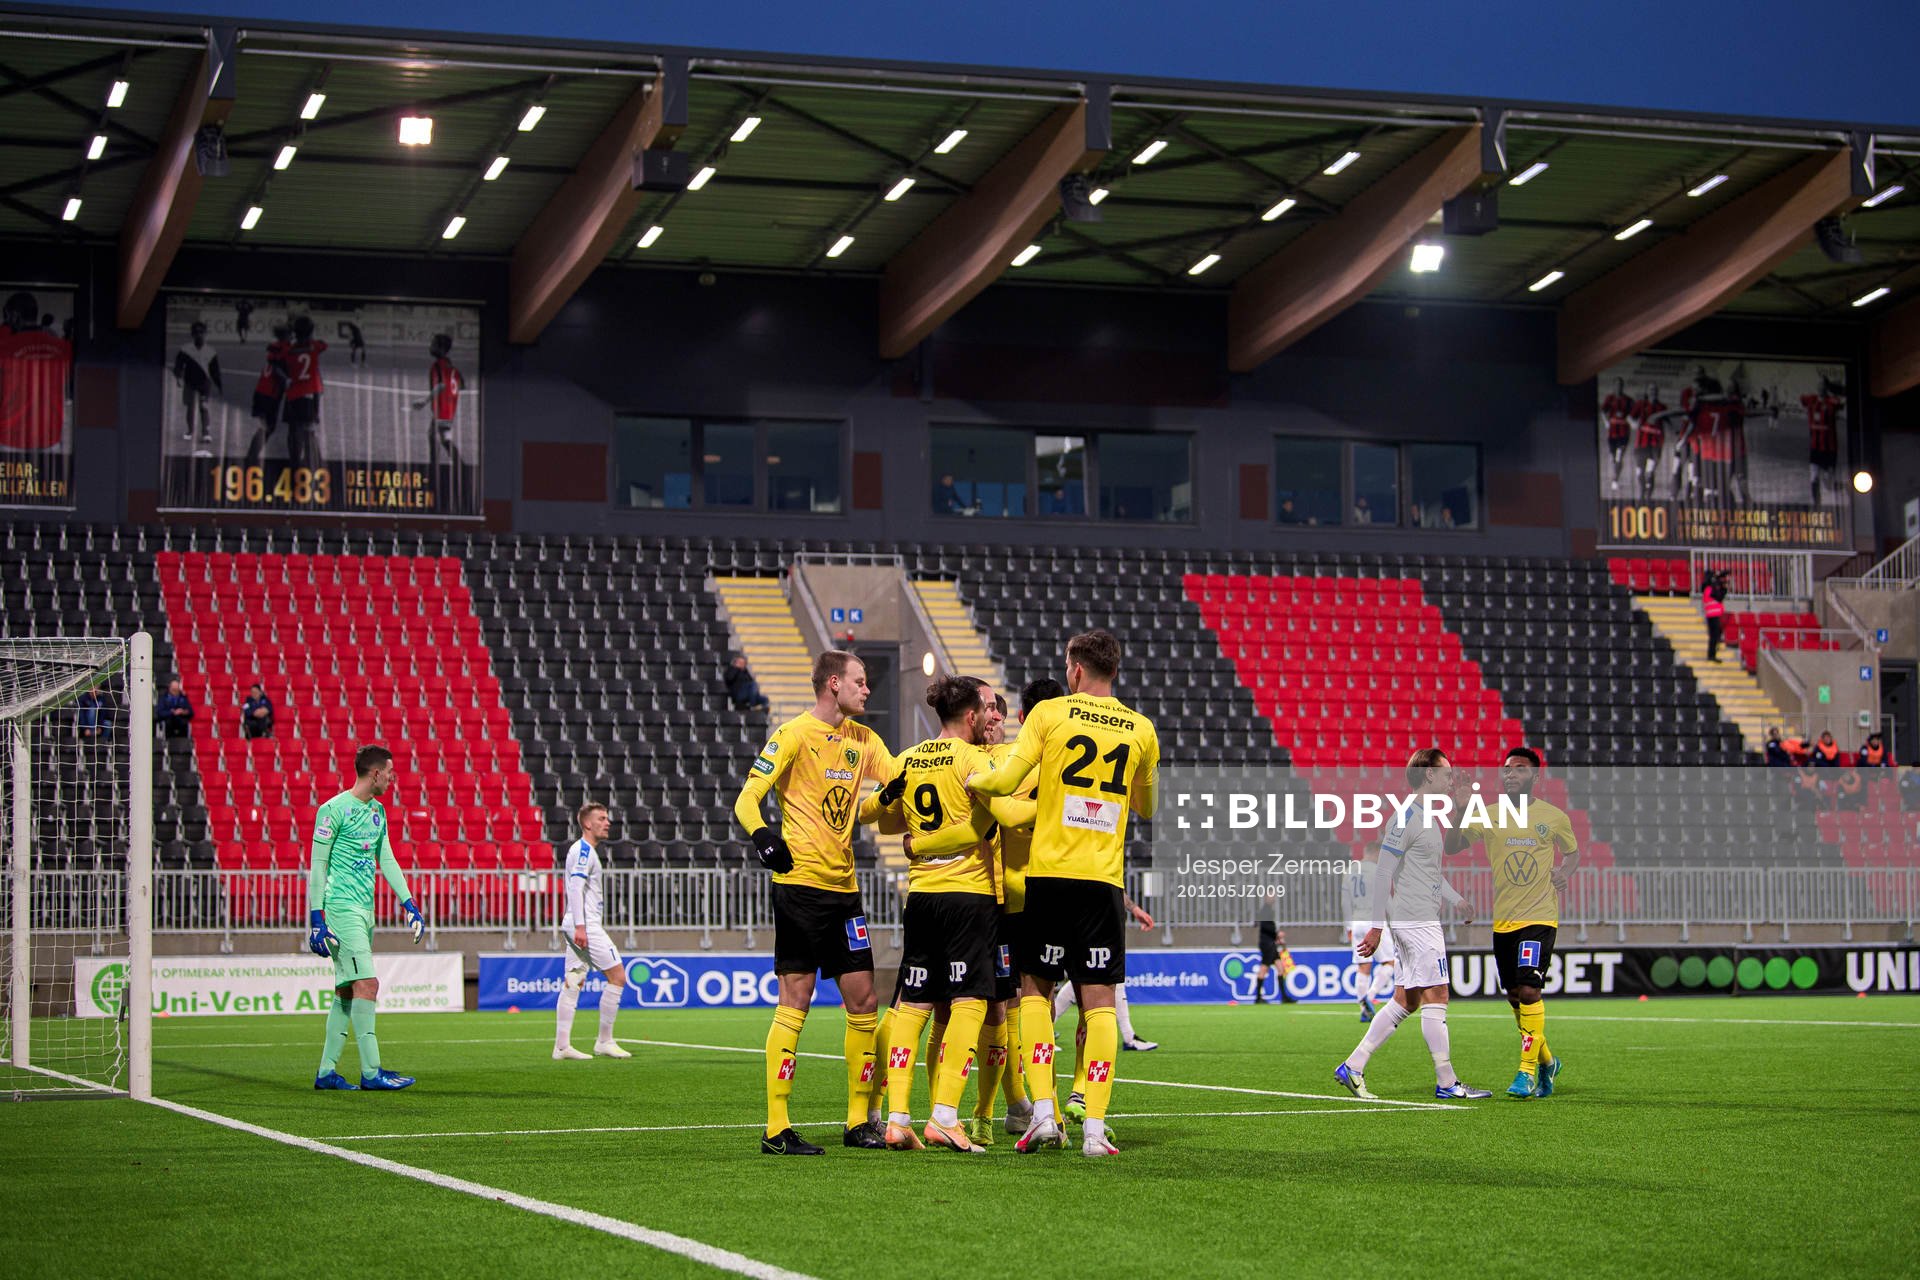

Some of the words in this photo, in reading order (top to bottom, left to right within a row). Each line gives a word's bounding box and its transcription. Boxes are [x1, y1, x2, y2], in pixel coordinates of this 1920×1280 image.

[298, 352, 311, 380] 2
[211, 464, 331, 504] 196.483
[347, 469, 429, 488] DELTAGAR-
[347, 486, 434, 508] TILLFÄLLEN
[1609, 506, 1668, 540] 1000
[1069, 707, 1135, 732] Passera
[904, 755, 953, 770] Passera
[1061, 734, 1130, 796] 21
[914, 783, 943, 831] 9
[1067, 815, 1089, 824] YUASA
[1040, 944, 1065, 965] JP
[1086, 947, 1111, 968] JP
[161, 967, 225, 978] OPTIMERAR
[904, 966, 928, 987] JP
[949, 961, 967, 982] JP
[1124, 971, 1177, 987] ostäder
[1179, 971, 1208, 987] från
[1451, 953, 1623, 997] UNBET
[1846, 951, 1920, 992] UNI
[507, 976, 567, 993] Bostäd
[696, 970, 817, 1005] OBO
[151, 990, 283, 1013] Uni-Vent
[295, 989, 335, 1011] AB
